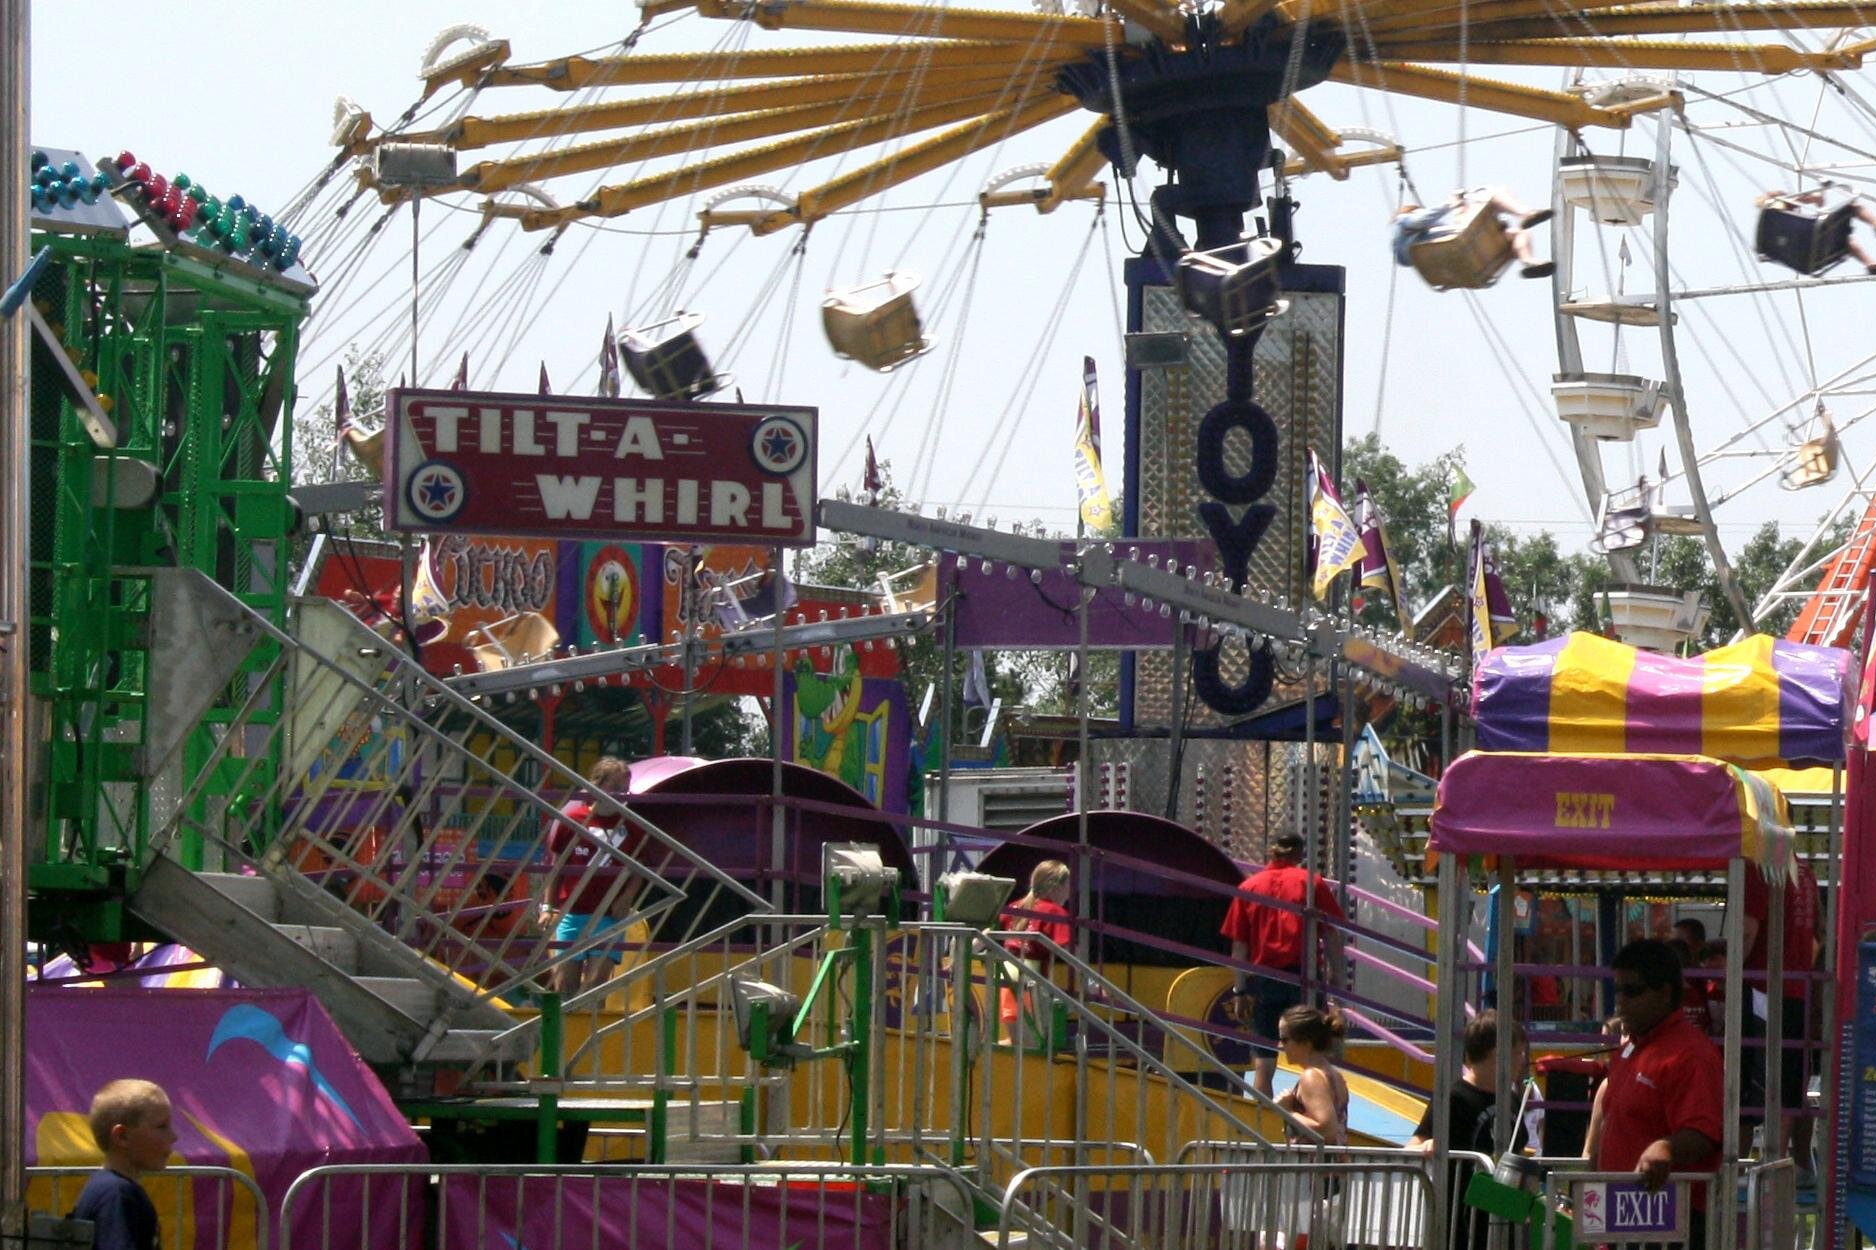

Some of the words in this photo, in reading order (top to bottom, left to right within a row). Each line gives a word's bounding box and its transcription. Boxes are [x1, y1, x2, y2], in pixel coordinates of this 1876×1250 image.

[536, 474, 793, 529] WHIRL
[1554, 792, 1615, 829] EXIT
[1614, 1191, 1669, 1227] EXIT
